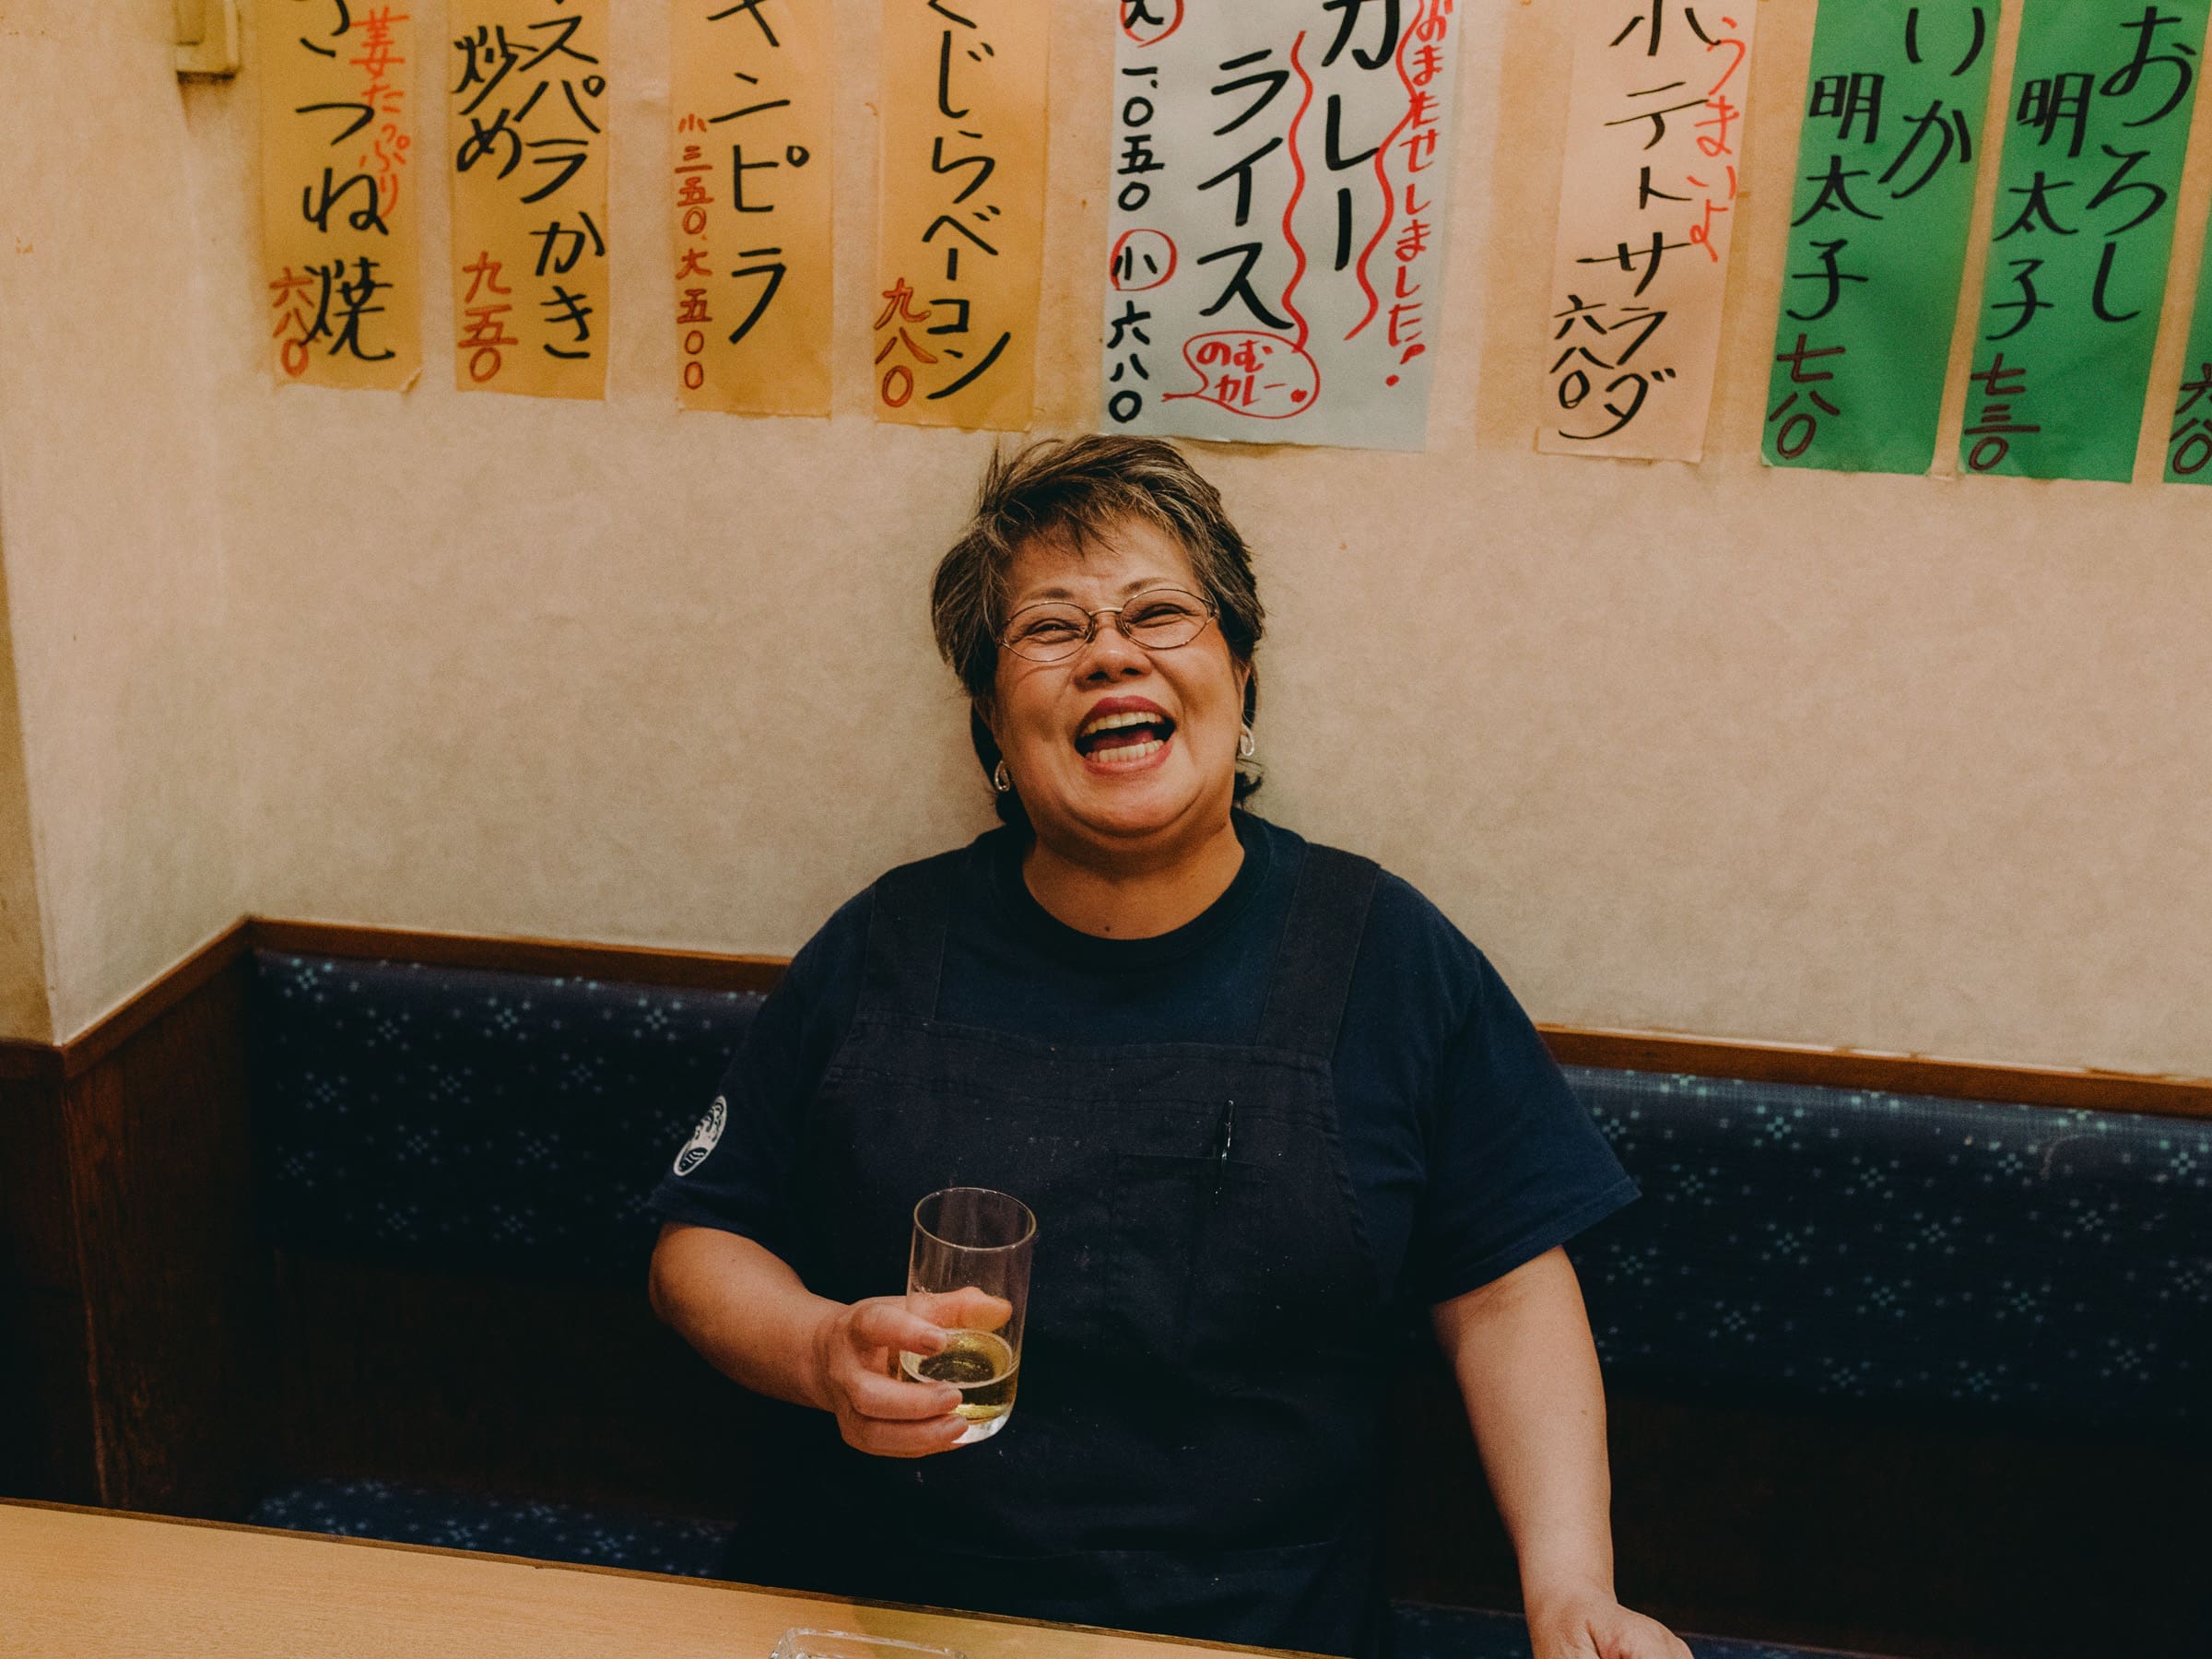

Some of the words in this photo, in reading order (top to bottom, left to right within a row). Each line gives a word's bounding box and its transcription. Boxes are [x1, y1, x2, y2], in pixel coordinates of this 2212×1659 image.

[451, 24, 538, 181] 炒め
[512, 0, 607, 359] スパラかき
[1197, 49, 1295, 330] ライス
[1687, 16, 1747, 263] うまいよ
[1786, 72, 1885, 322] 明太子
[1986, 72, 2096, 341] 明太子
[2086, 6, 2197, 324] おろし
[1195, 339, 1274, 373] のむ
